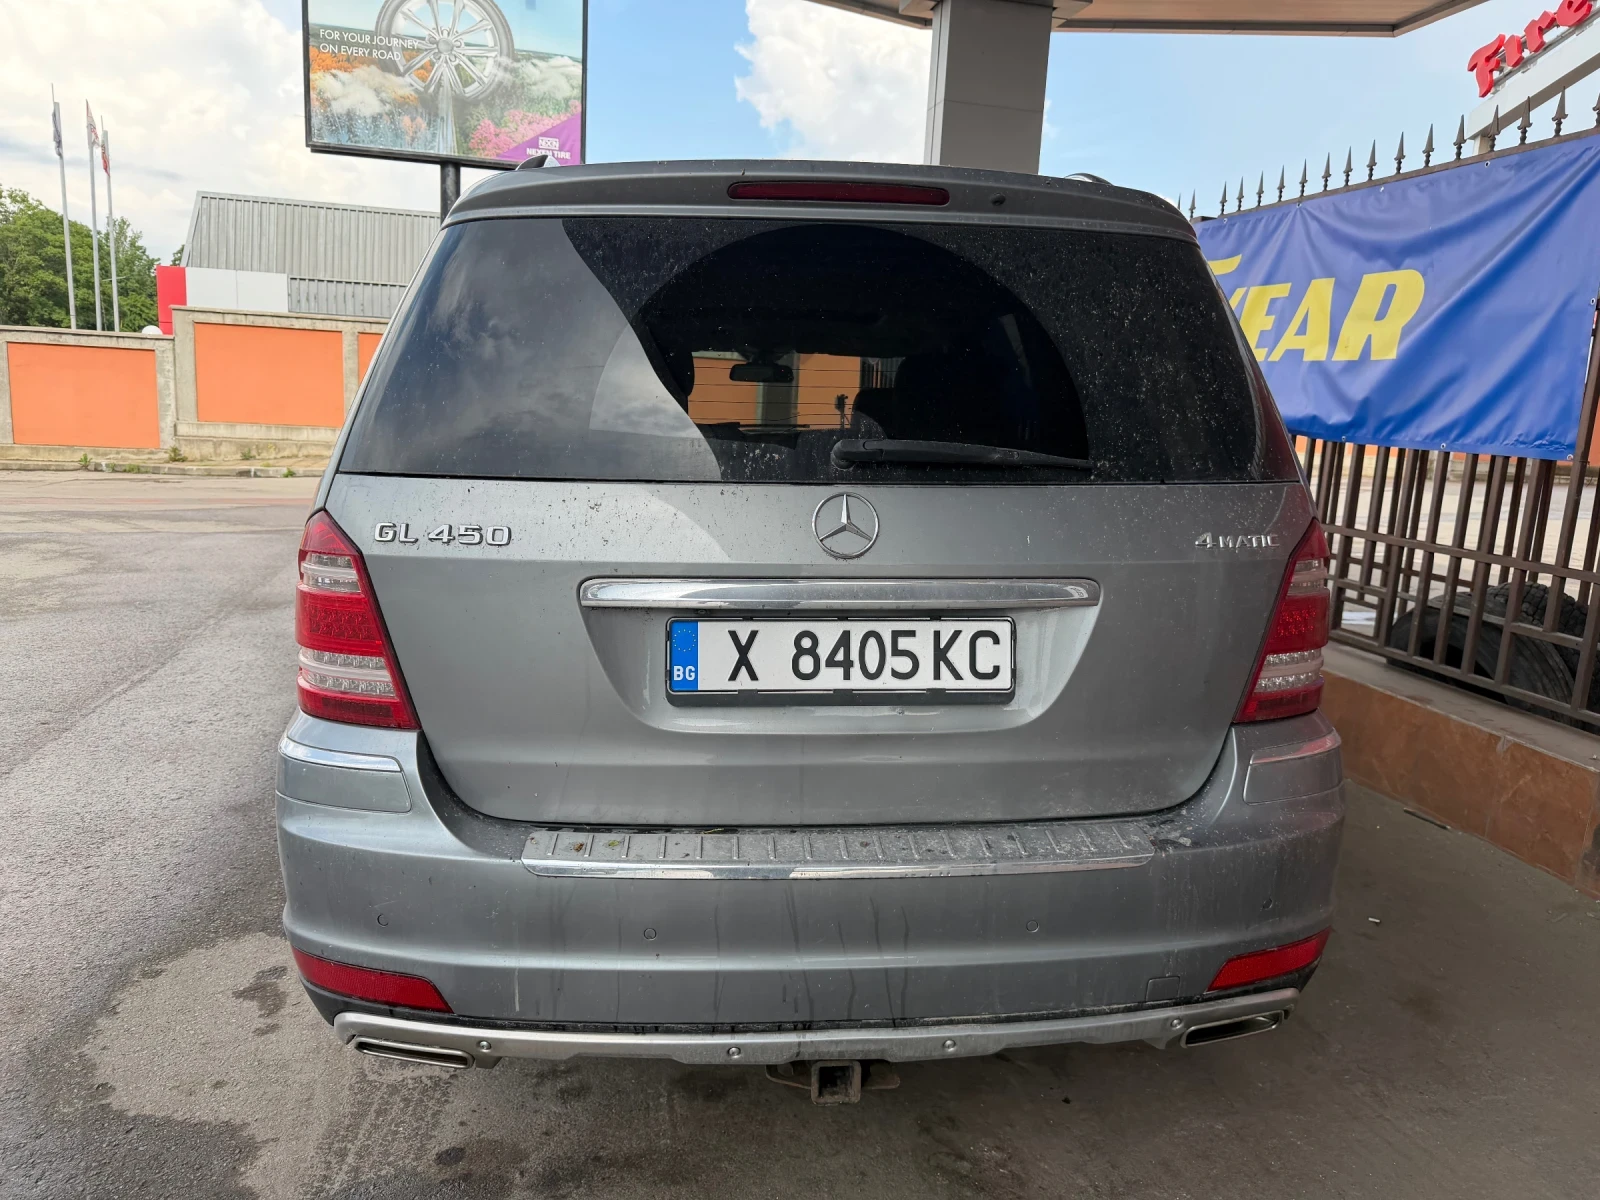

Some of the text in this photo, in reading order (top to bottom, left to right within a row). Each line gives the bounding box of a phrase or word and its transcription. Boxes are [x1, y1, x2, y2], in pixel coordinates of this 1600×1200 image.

[320, 29, 419, 49] FOR YOUR JOURNEY
[320, 43, 401, 61] ON EVERY ROAD
[553, 151, 571, 159] TIRE
[374, 522, 512, 546] GL 450
[727, 629, 760, 682] X
[672, 665, 696, 681] BG
